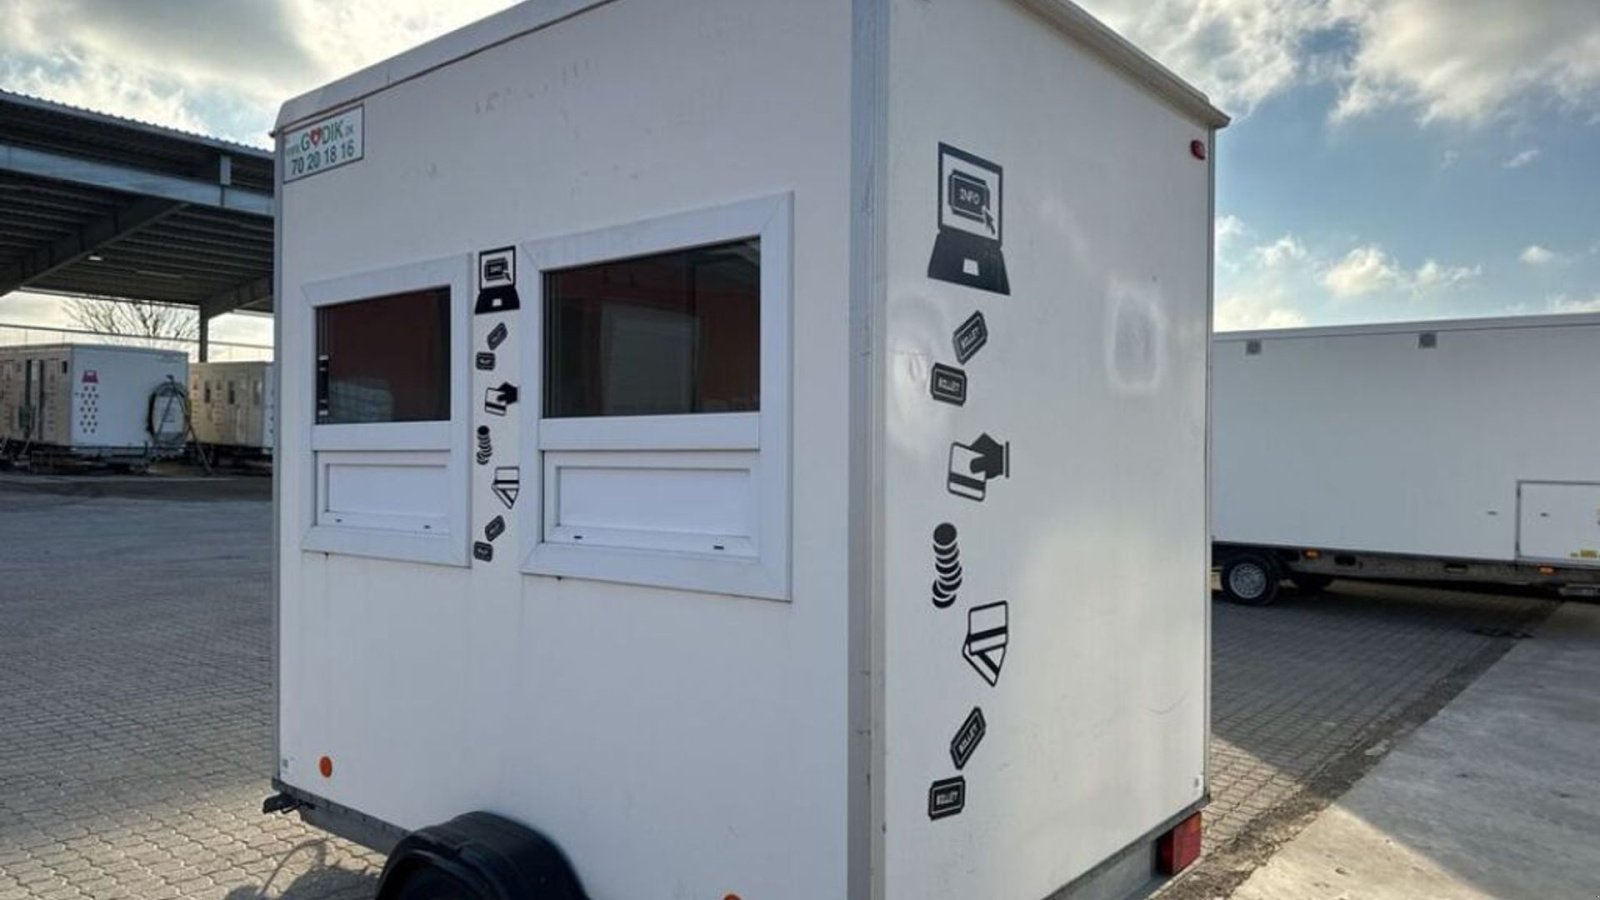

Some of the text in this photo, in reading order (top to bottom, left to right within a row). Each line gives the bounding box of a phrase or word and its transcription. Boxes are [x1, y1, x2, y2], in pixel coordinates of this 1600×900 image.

[291, 139, 355, 176] 70 20 18 16
